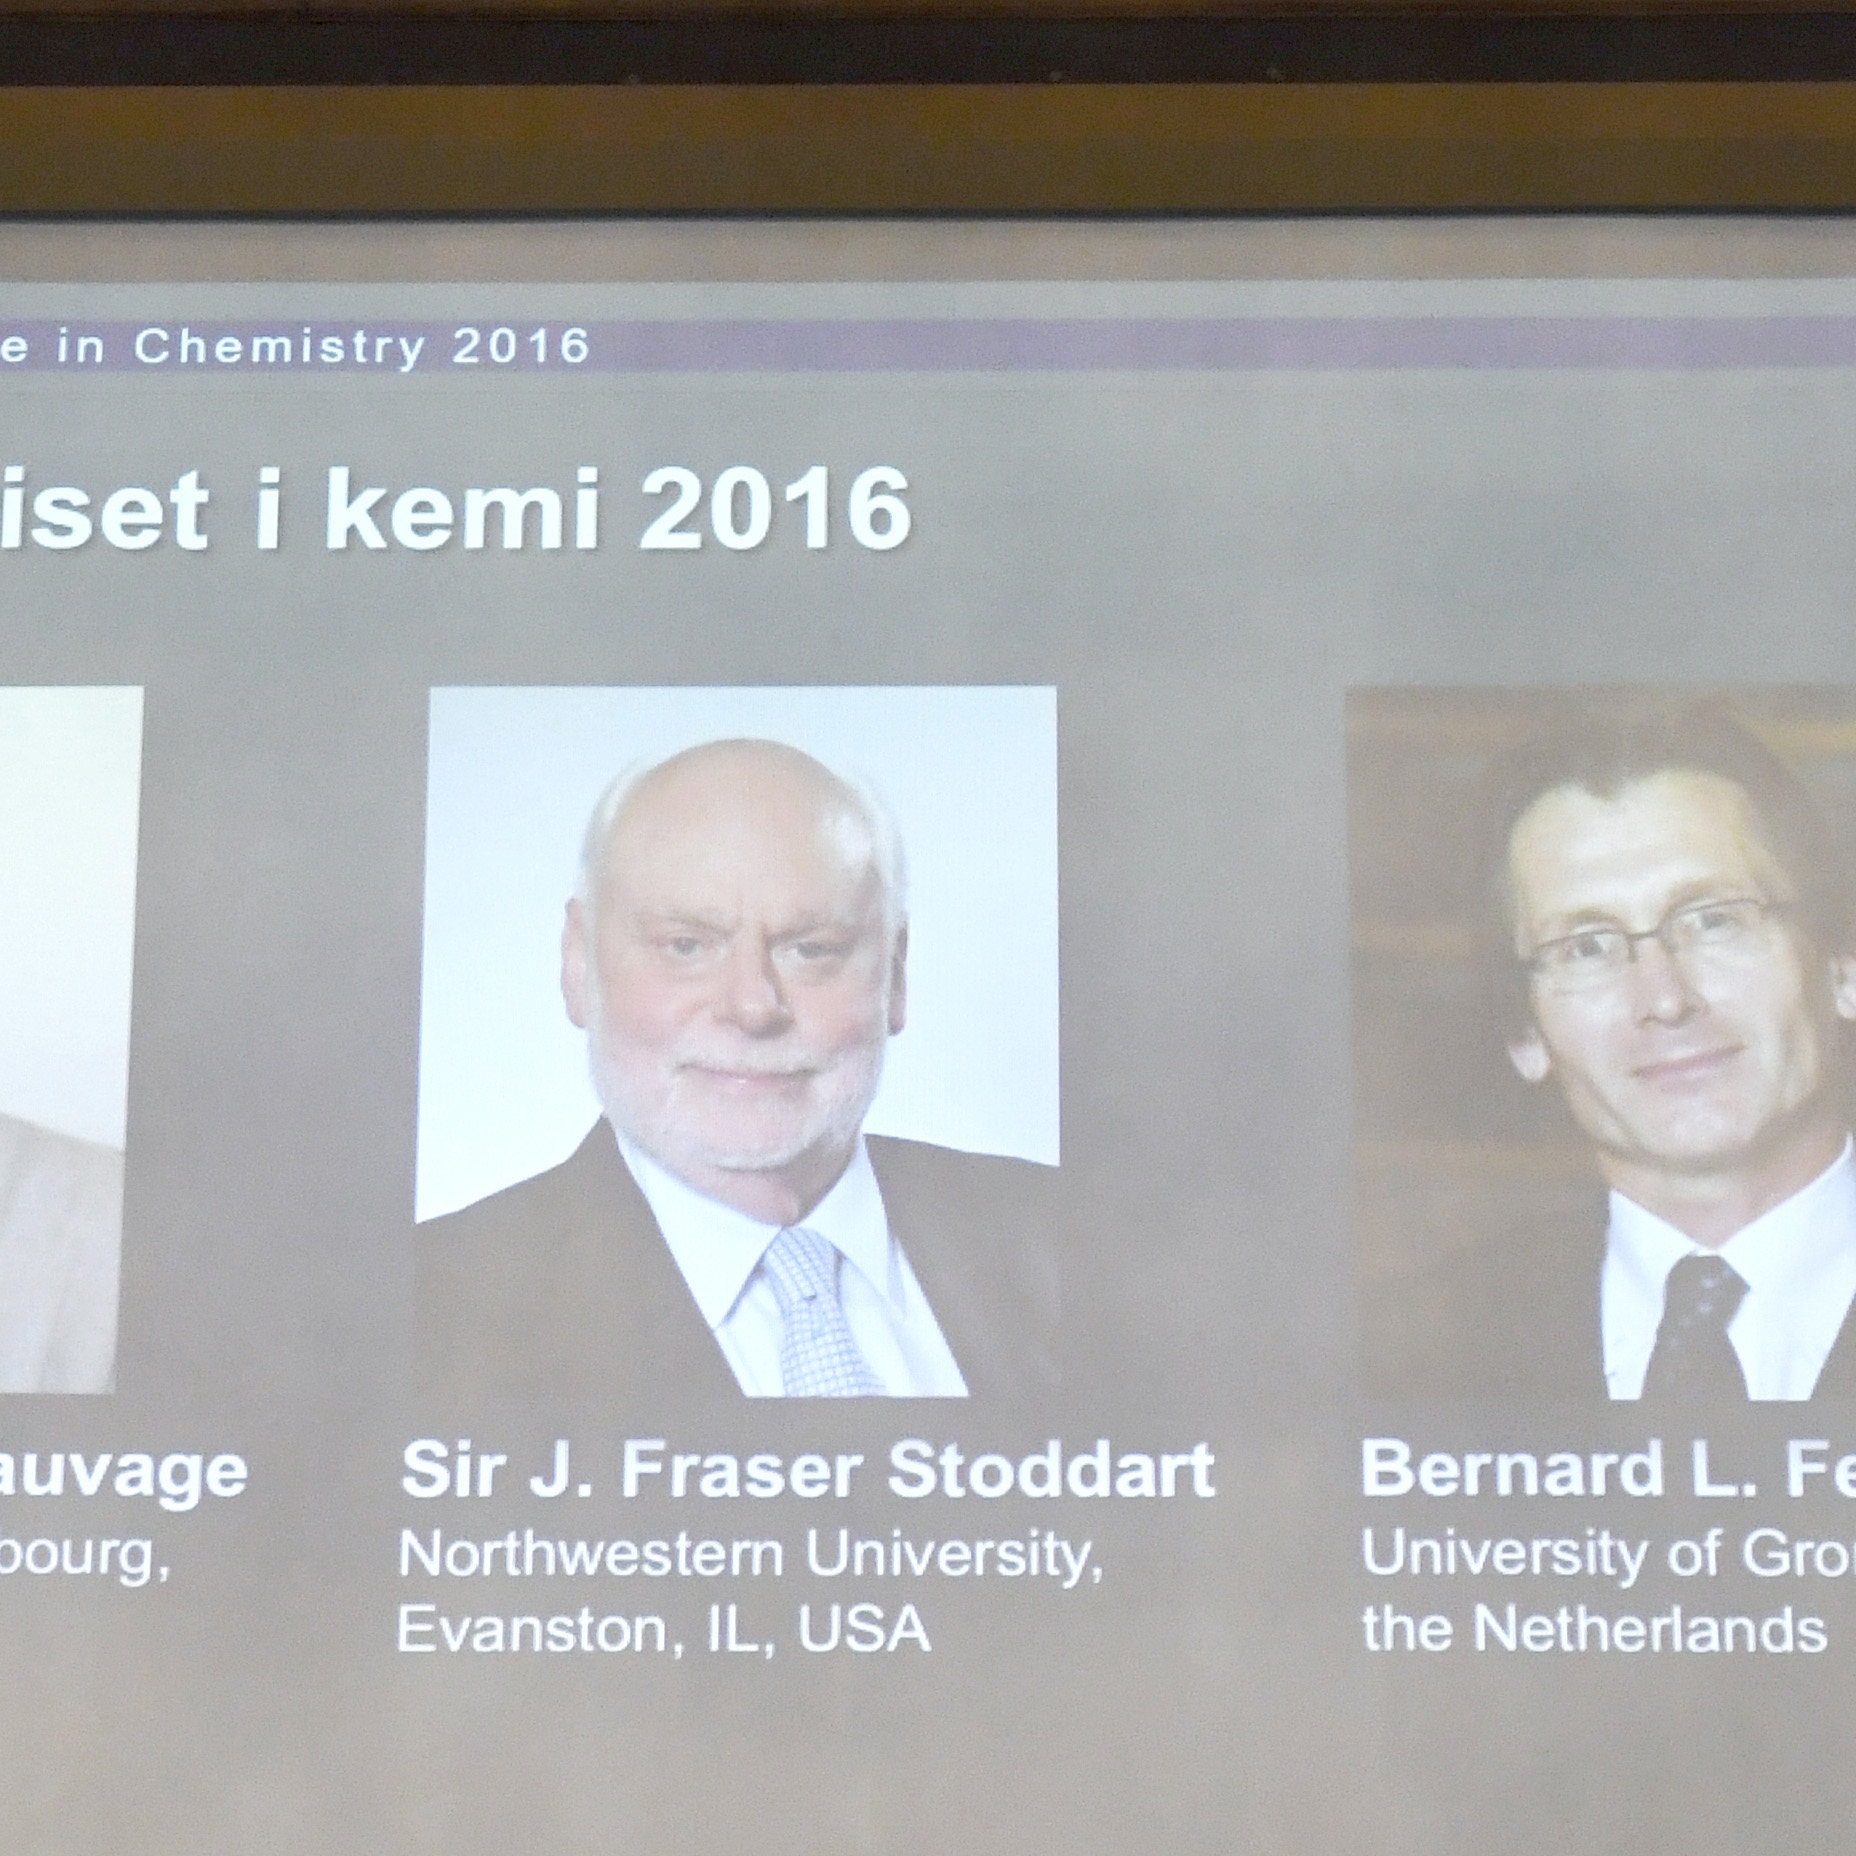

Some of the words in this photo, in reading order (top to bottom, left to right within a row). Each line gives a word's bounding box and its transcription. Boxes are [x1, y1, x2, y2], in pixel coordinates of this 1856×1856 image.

[58, 326, 104, 363] in
[135, 327, 425, 374] Chemistry
[452, 327, 589, 364] 2016
[257, 466, 281, 550] i
[326, 466, 599, 550] kemi
[638, 465, 912, 550] 2016
[401, 1438, 509, 1498] Sir
[529, 1438, 593, 1498] J.
[623, 1438, 866, 1498] Fraser
[887, 1438, 1218, 1498] Stoddart
[1361, 1438, 1665, 1498] Bernard
[1693, 1438, 1757, 1498] L.
[398, 1528, 784, 1577] Northwestern
[806, 1528, 1103, 1590] University,
[1363, 1527, 1650, 1589] University
[1667, 1526, 1725, 1577] of
[396, 1602, 685, 1661] Evanston,
[709, 1602, 774, 1660] IL,
[798, 1602, 933, 1653] USA
[1361, 1602, 1455, 1653] the
[1473, 1602, 1829, 1653] Netherlands
